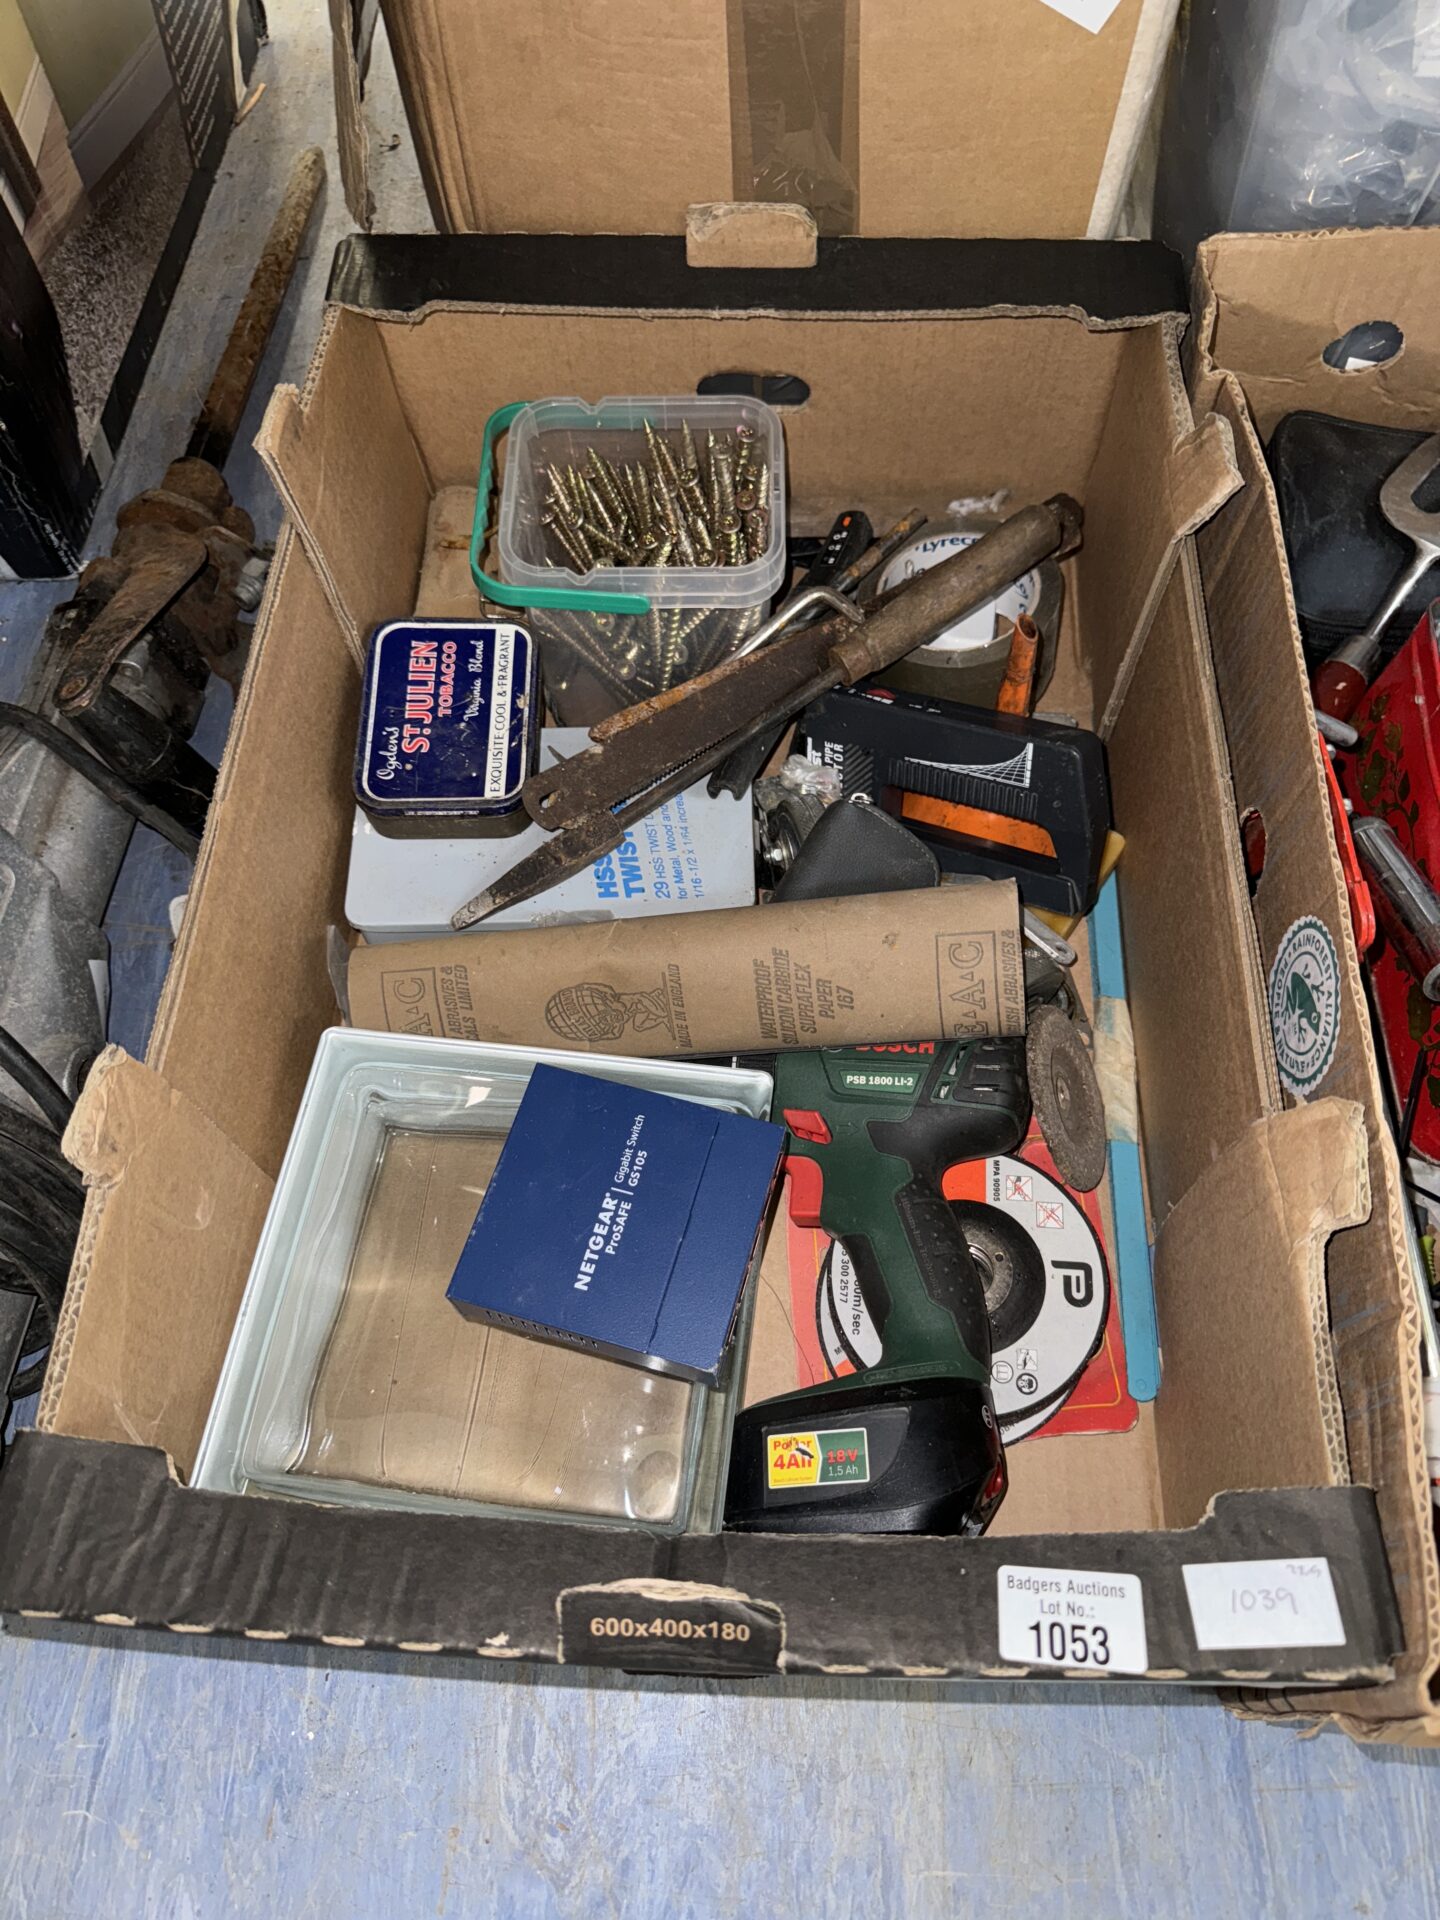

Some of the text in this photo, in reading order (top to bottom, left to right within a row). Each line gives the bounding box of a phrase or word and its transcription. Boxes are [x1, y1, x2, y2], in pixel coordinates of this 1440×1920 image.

[404, 640, 438, 723] JULIEN
[438, 641, 457, 717] TOBACCO
[463, 639, 485, 722] Virginia Blend
[824, 741, 834, 764] PIPE
[675, 792, 688, 824] increa
[645, 823, 660, 854] TWIST
[662, 824, 678, 853] Wood
[652, 857, 667, 879] HSS
[687, 857, 699, 871] 1/2
[652, 881, 671, 899] 29
[676, 887, 688, 900] for
[691, 878, 704, 898] 1/16
[454, 965, 474, 1011] LIMITED
[772, 947, 792, 1003] CARBIDE
[1273, 960, 1289, 1019] PEOPLE
[441, 977, 464, 1035] ABRASIVES
[668, 963, 693, 1048] MADE IN ENGLAND
[753, 958, 778, 1039] WATERPROOF
[794, 962, 817, 1034] SUPRAFLEX
[816, 978, 835, 1019] PAPER
[836, 985, 854, 1010] 167
[1292, 932, 1333, 1068] RAINFOREST ALLIANCE
[1276, 1041, 1305, 1073] NATURE
[846, 1075, 866, 1084] PSB
[868, 1076, 893, 1085] 1800
[574, 1114, 645, 1291] NETGEAR Gigabit Switch
[605, 1150, 647, 1255] ProSAFE GS105
[841, 1259, 850, 1277] 300
[839, 1280, 849, 1304] 2577
[774, 1439, 812, 1450] Por
[827, 1448, 858, 1464] 18V
[846, 1464, 858, 1475] Ah
[1007, 1575, 1126, 1599] Badgers Auctions
[1231, 1587, 1299, 1615] 1039
[1040, 1600, 1061, 1615] Lot
[590, 1617, 750, 1642] 600x400x180
[1029, 1620, 1110, 1666] 1053
